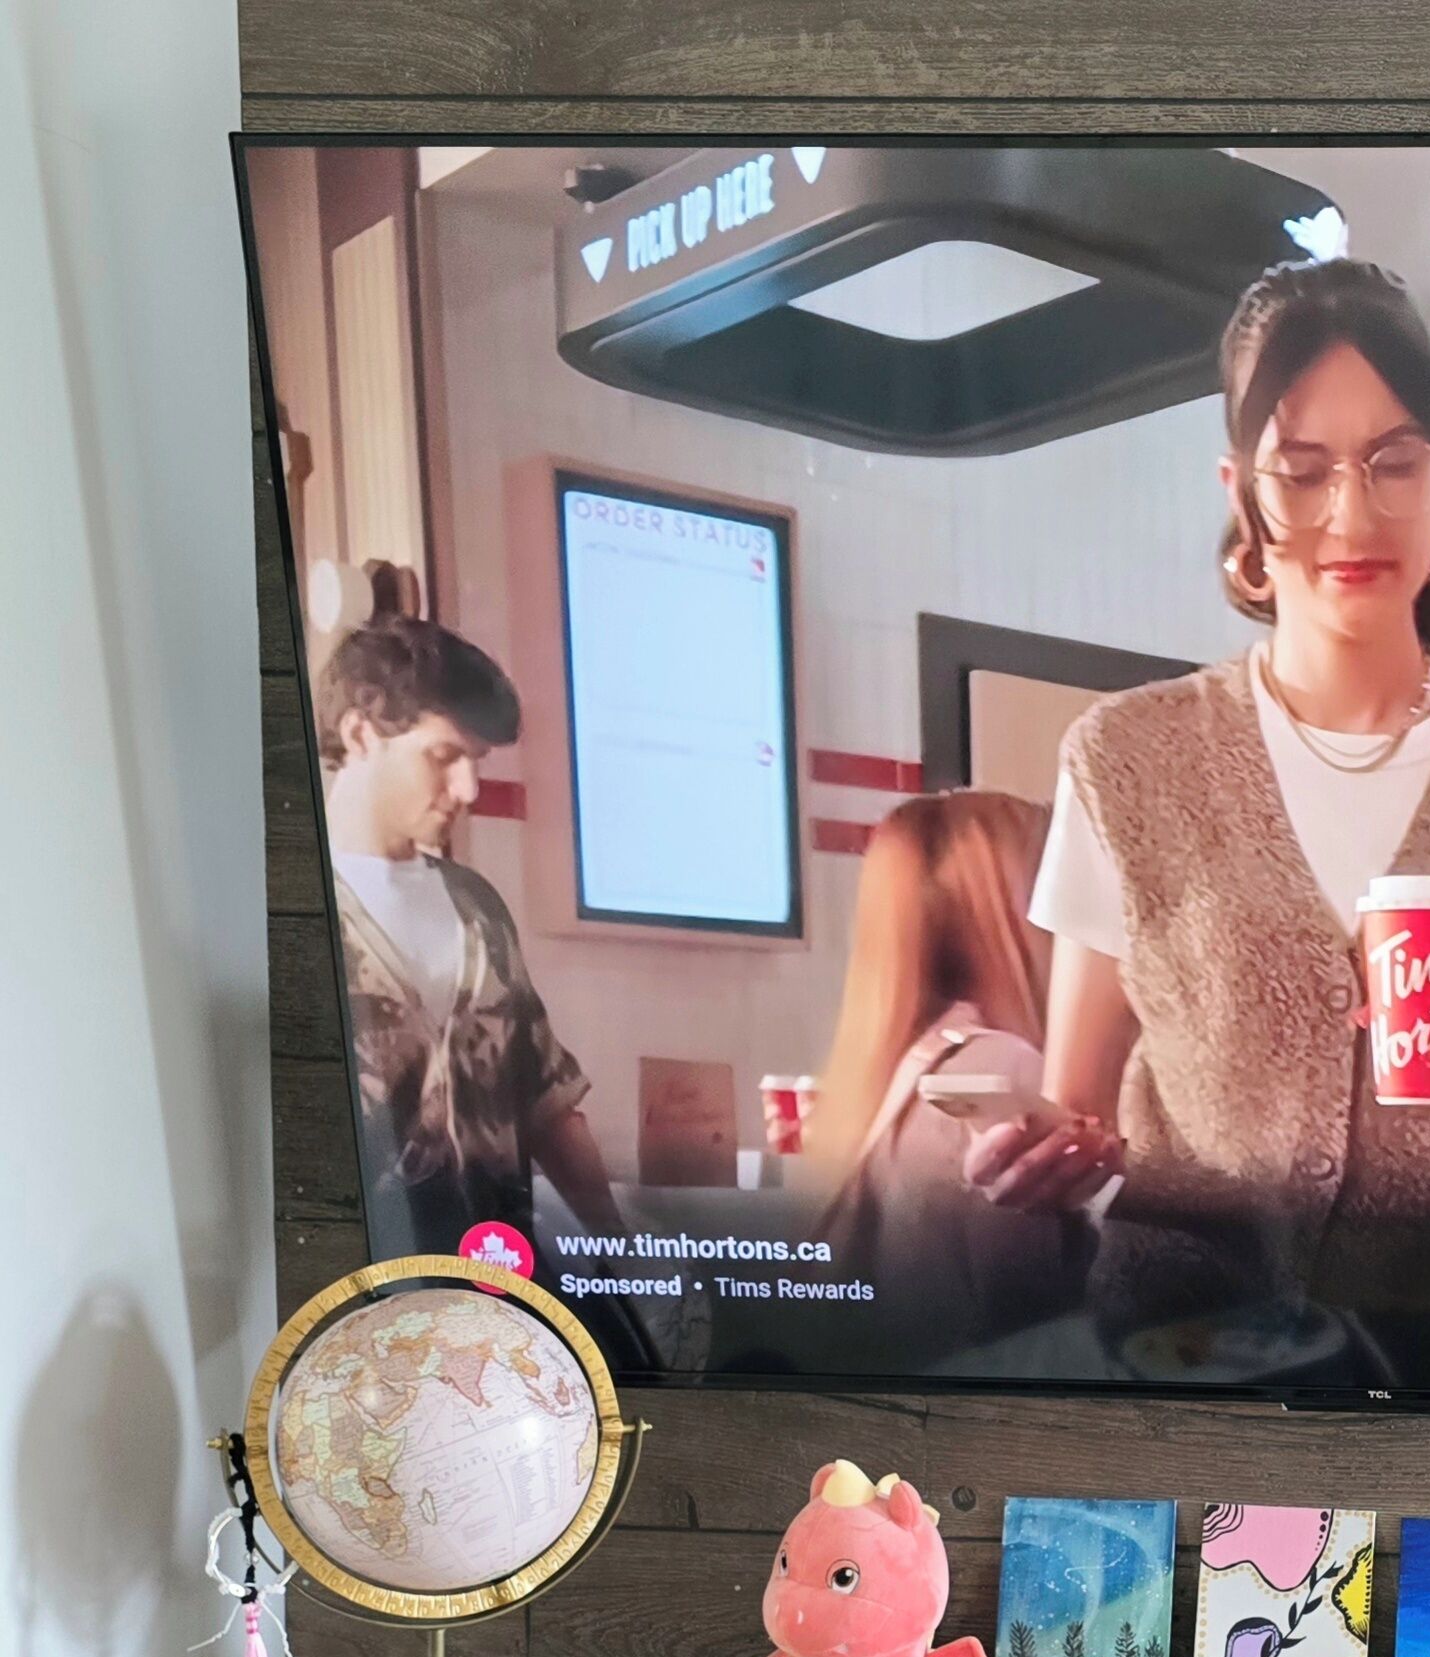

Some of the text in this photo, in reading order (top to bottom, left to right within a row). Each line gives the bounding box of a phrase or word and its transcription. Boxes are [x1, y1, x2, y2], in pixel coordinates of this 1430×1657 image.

[626, 153, 777, 273] PICK UP HERE
[573, 496, 664, 534] ORDER
[672, 514, 769, 554] STATUS
[556, 1231, 833, 1265] www.timhortons.ca
[559, 1271, 876, 1303] Sponsored Tims Rewards
[1367, 1390, 1392, 1399] TCL
